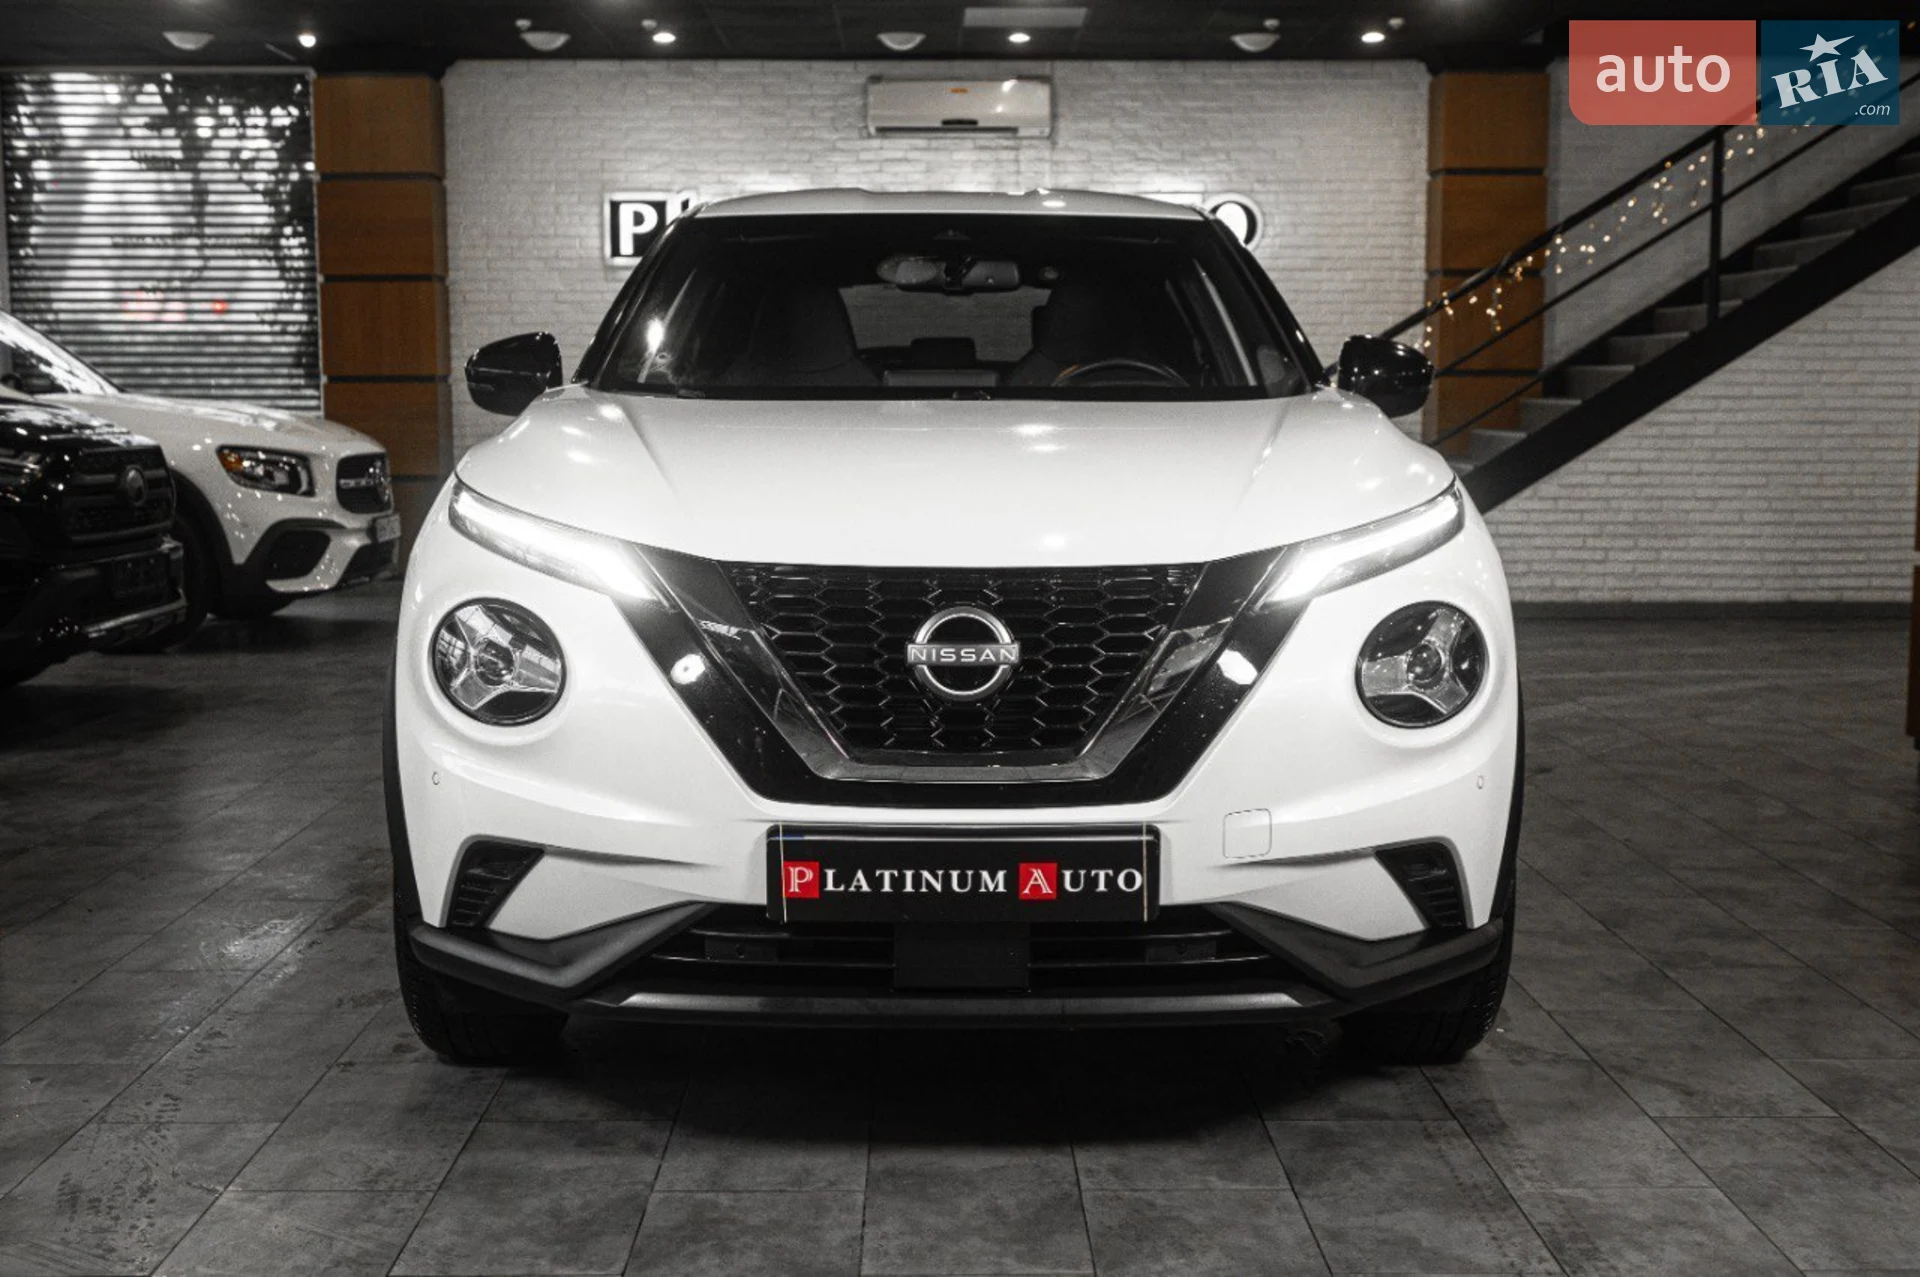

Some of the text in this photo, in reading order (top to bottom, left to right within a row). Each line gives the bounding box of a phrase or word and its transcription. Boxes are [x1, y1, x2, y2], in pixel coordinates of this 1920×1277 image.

[911, 647, 1017, 662] NISSAN
[787, 866, 1143, 895] PLATINUM AUTO
